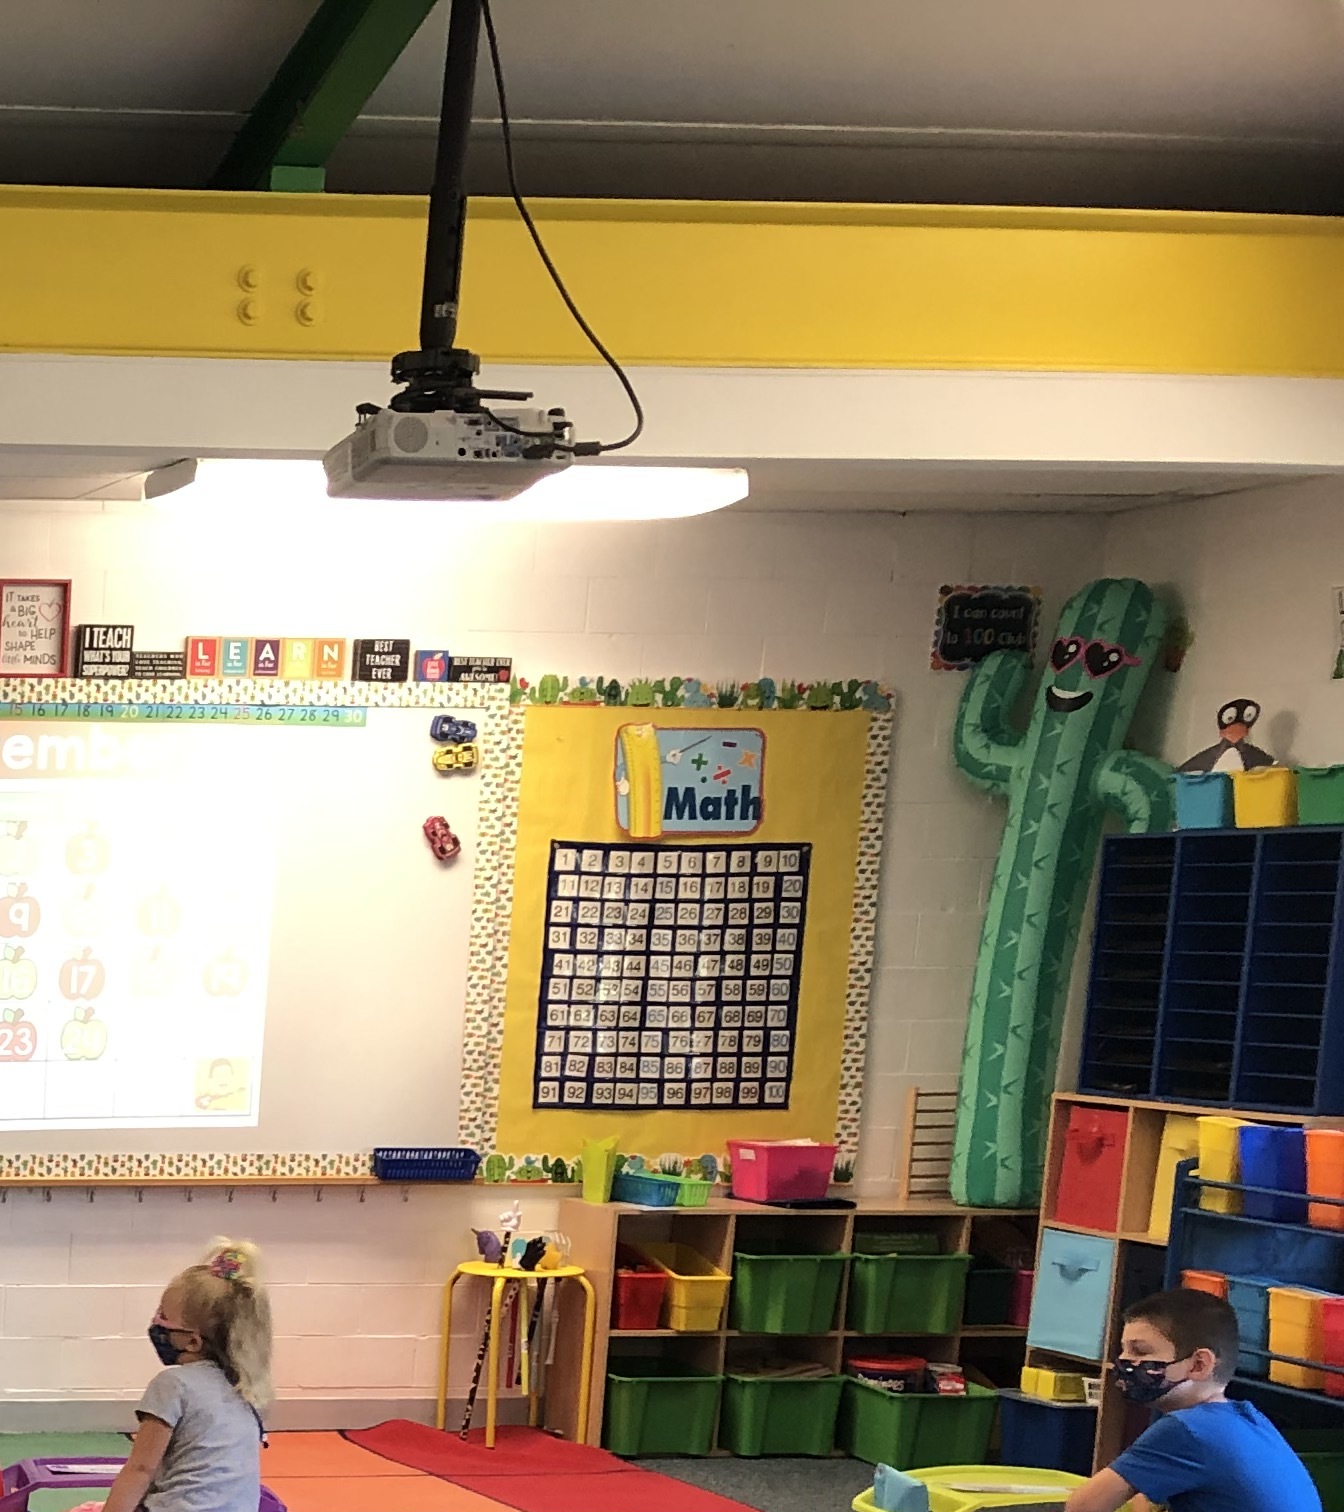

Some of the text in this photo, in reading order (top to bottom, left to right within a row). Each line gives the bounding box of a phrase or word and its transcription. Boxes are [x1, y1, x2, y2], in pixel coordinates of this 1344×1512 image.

[5, 591, 15, 603] IT
[17, 605, 37, 617] BIG
[2, 615, 39, 628] heart
[30, 628, 57, 640] HELP
[84, 627, 133, 649] I TEACH
[4, 641, 36, 651] SHAPE
[198, 641, 210, 660] L
[229, 641, 242, 660] E
[258, 642, 276, 661] A
[292, 642, 307, 661] R
[323, 643, 339, 662] N
[373, 640, 394, 652] BEST
[23, 653, 57, 666] MINDS
[365, 654, 402, 667] TEACHER
[371, 668, 393, 680] EVER
[663, 784, 761, 821] Math
[637, 856, 646, 869] 4
[633, 880, 649, 894] 14
[754, 906, 772, 920] 29
[579, 931, 596, 945] 32
[621, 1009, 638, 1023] 64
[666, 1086, 685, 1100] 96
